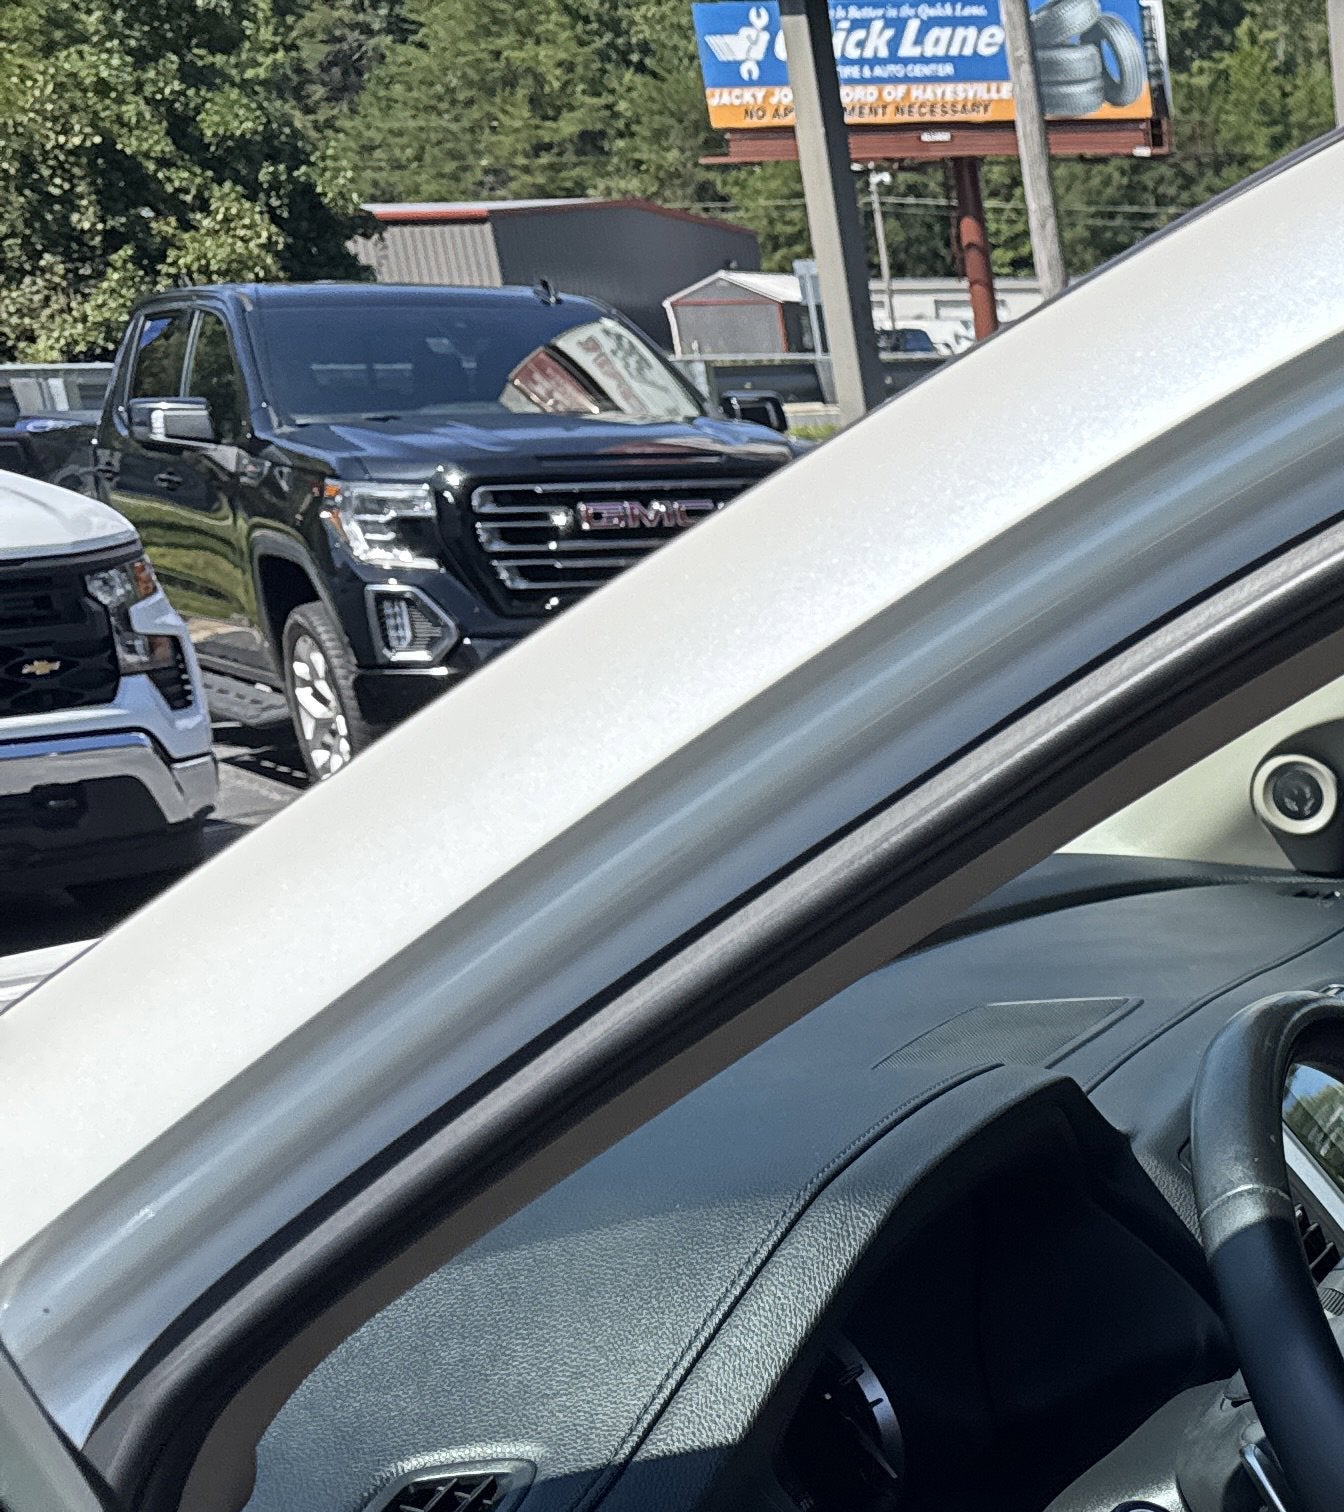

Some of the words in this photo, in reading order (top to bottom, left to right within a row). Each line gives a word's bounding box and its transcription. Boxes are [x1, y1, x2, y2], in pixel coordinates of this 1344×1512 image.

[897, 18, 1006, 57] Lane
[707, 87, 767, 106] JACKY
[881, 85, 909, 102] OF
[911, 82, 1013, 101] HAYESVILLE
[744, 106, 767, 120] NO
[895, 102, 992, 117] NECESSARY
